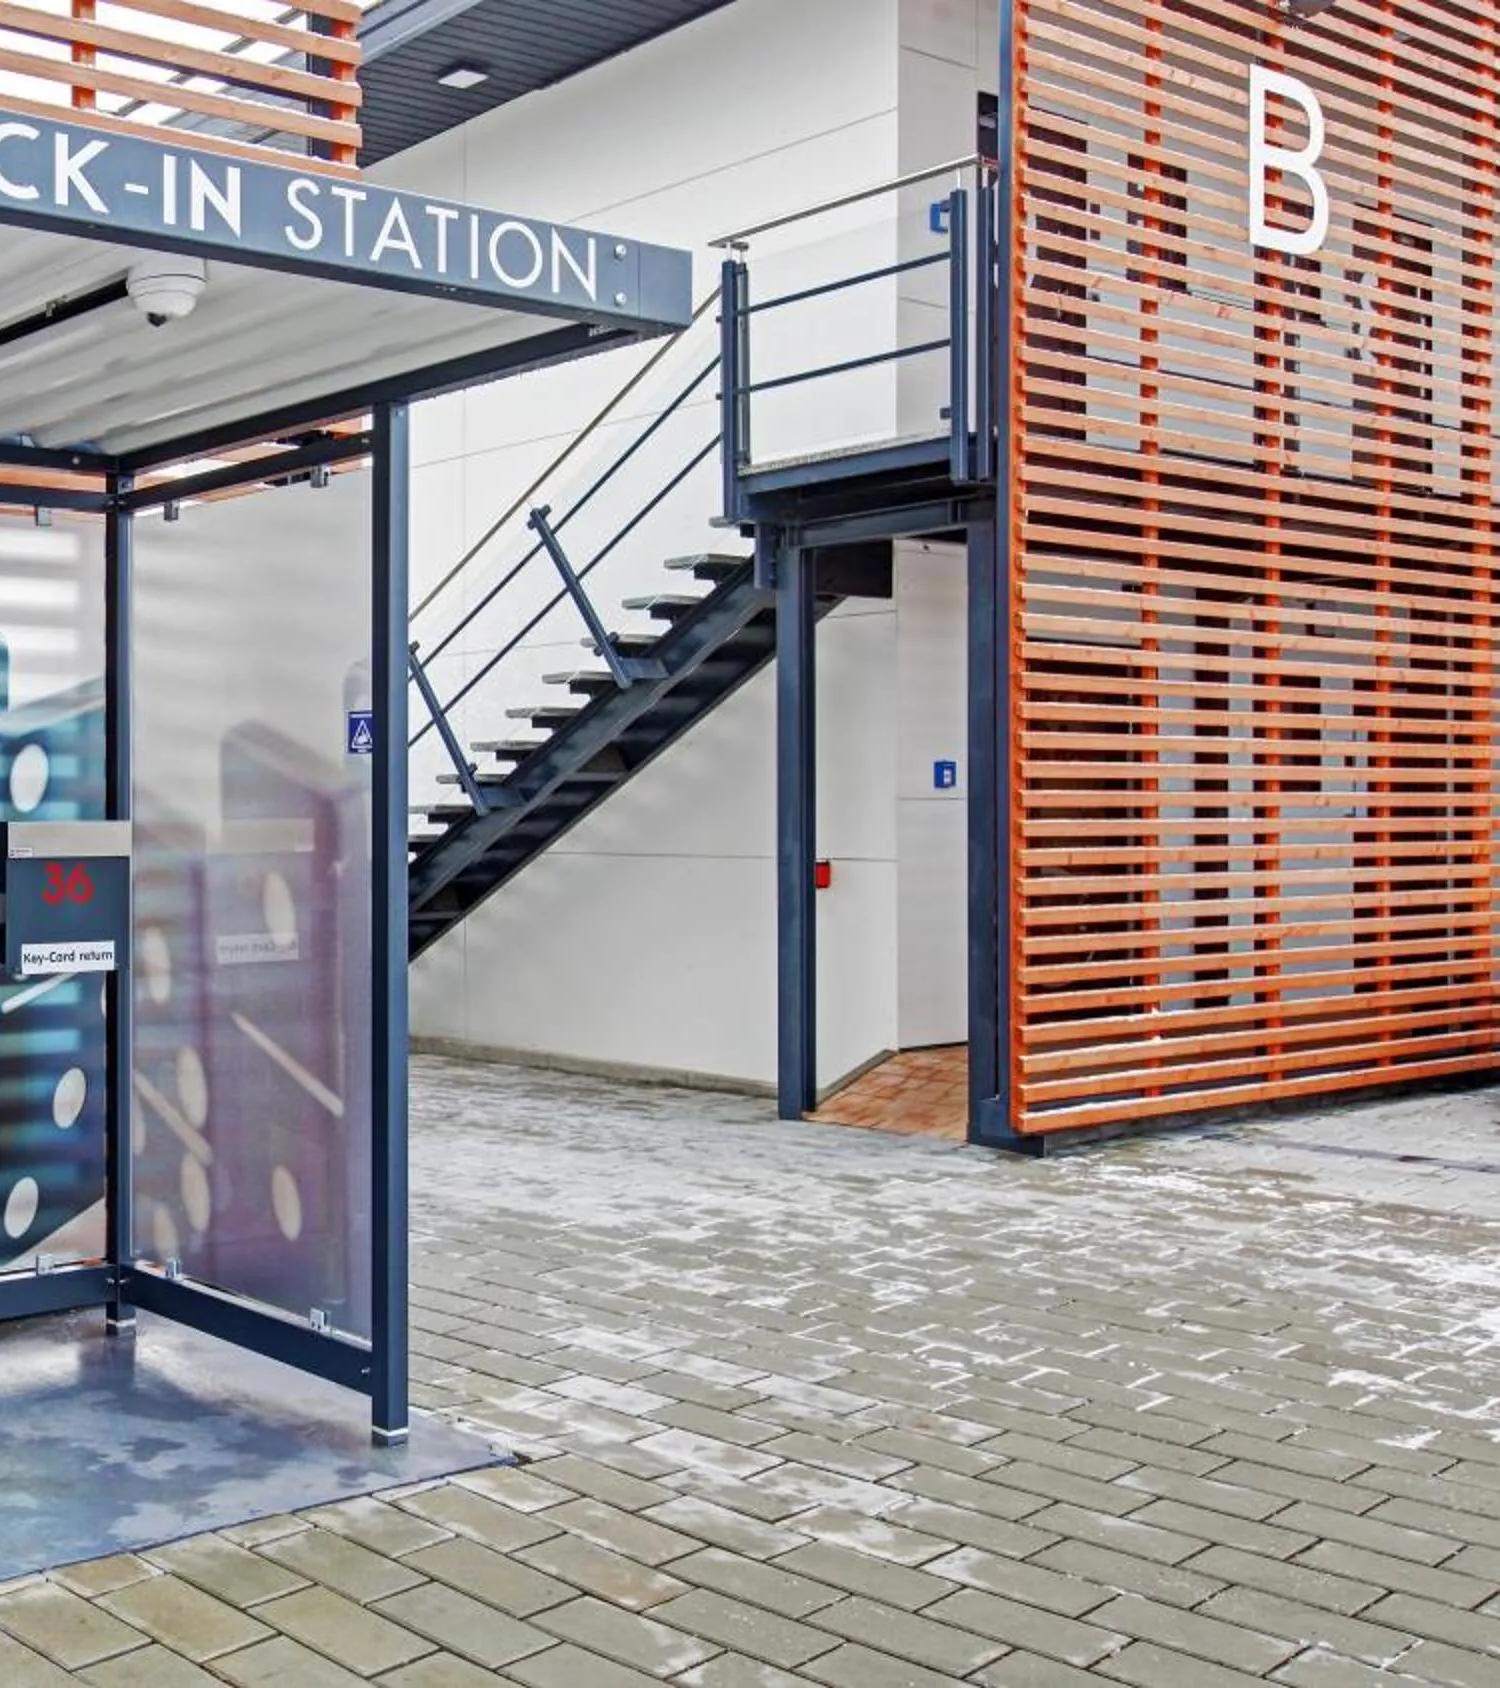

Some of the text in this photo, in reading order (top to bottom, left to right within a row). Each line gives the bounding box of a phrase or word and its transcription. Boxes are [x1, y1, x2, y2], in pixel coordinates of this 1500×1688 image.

[1249, 63, 1329, 255] B
[285, 178, 598, 302] STATION
[42, 863, 95, 904] 36
[22, 950, 113, 965] Key-Card return
